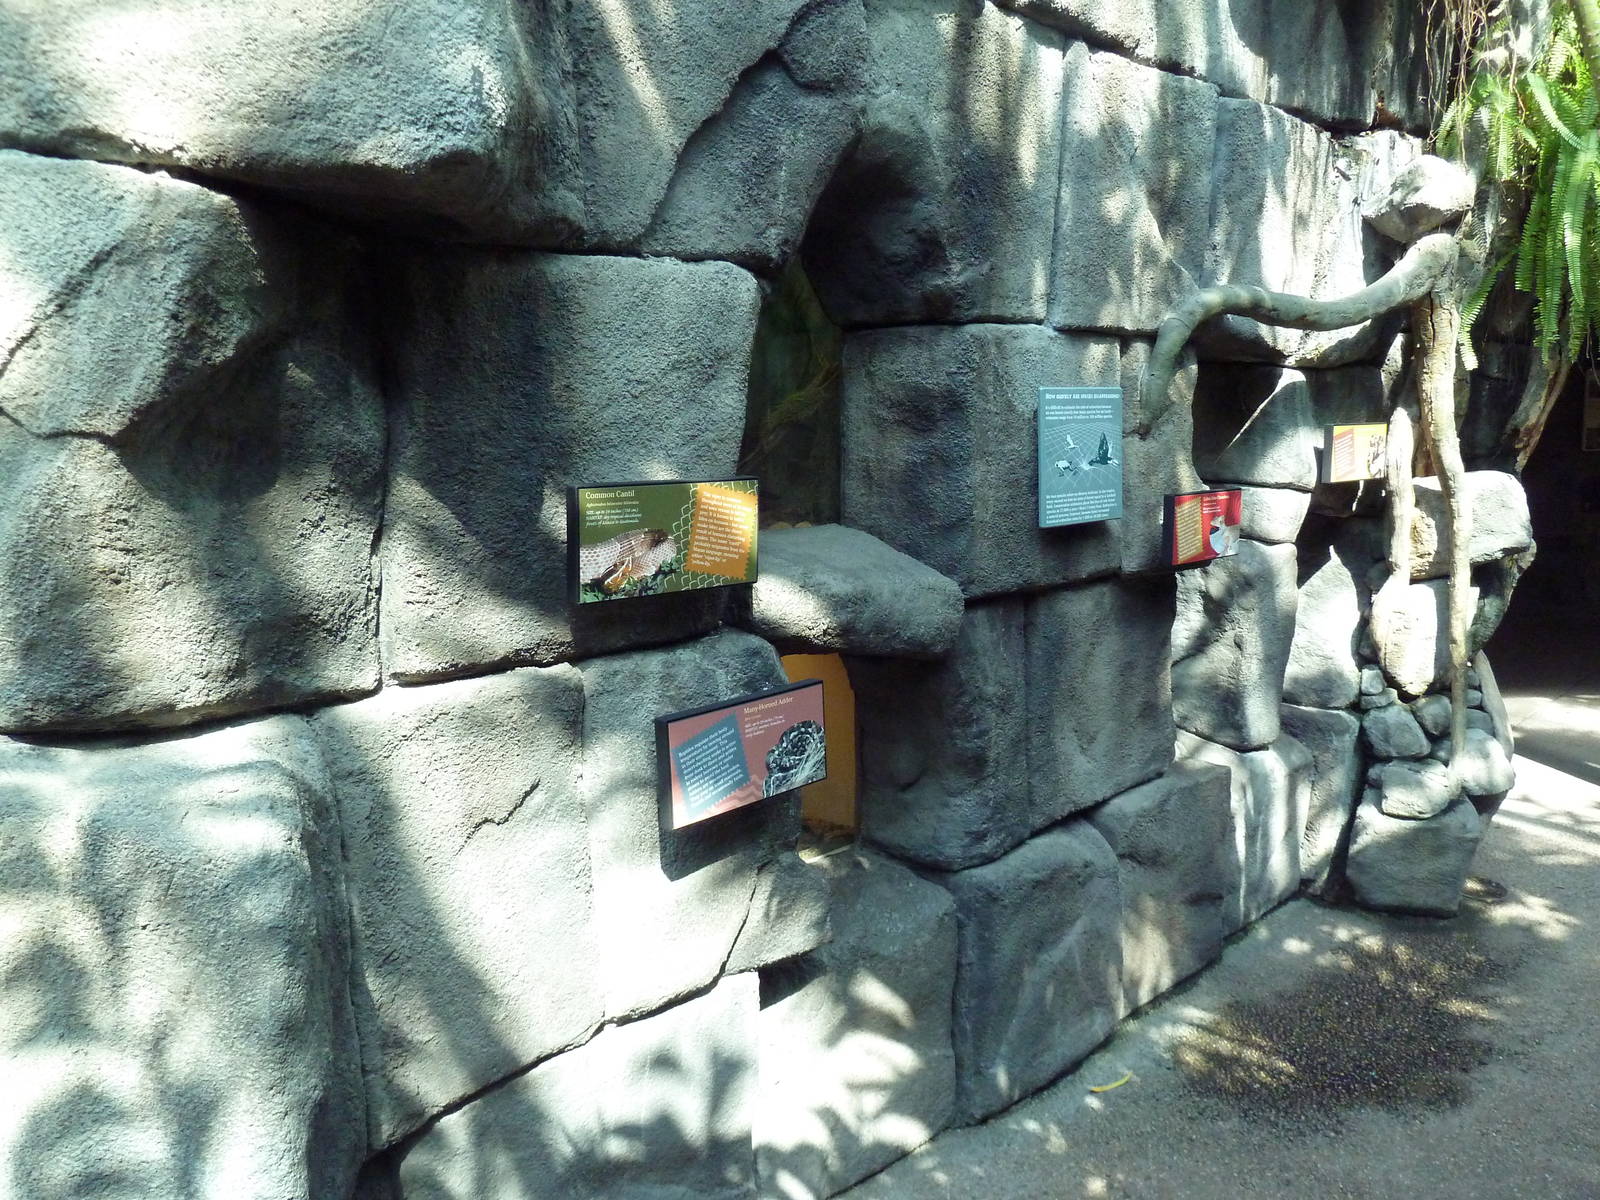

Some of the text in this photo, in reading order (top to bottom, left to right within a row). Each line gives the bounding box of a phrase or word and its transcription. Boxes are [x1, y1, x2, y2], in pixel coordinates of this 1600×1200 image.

[585, 490, 635, 499] Common Cantil
[744, 697, 794, 714] Many-Horned Adder
